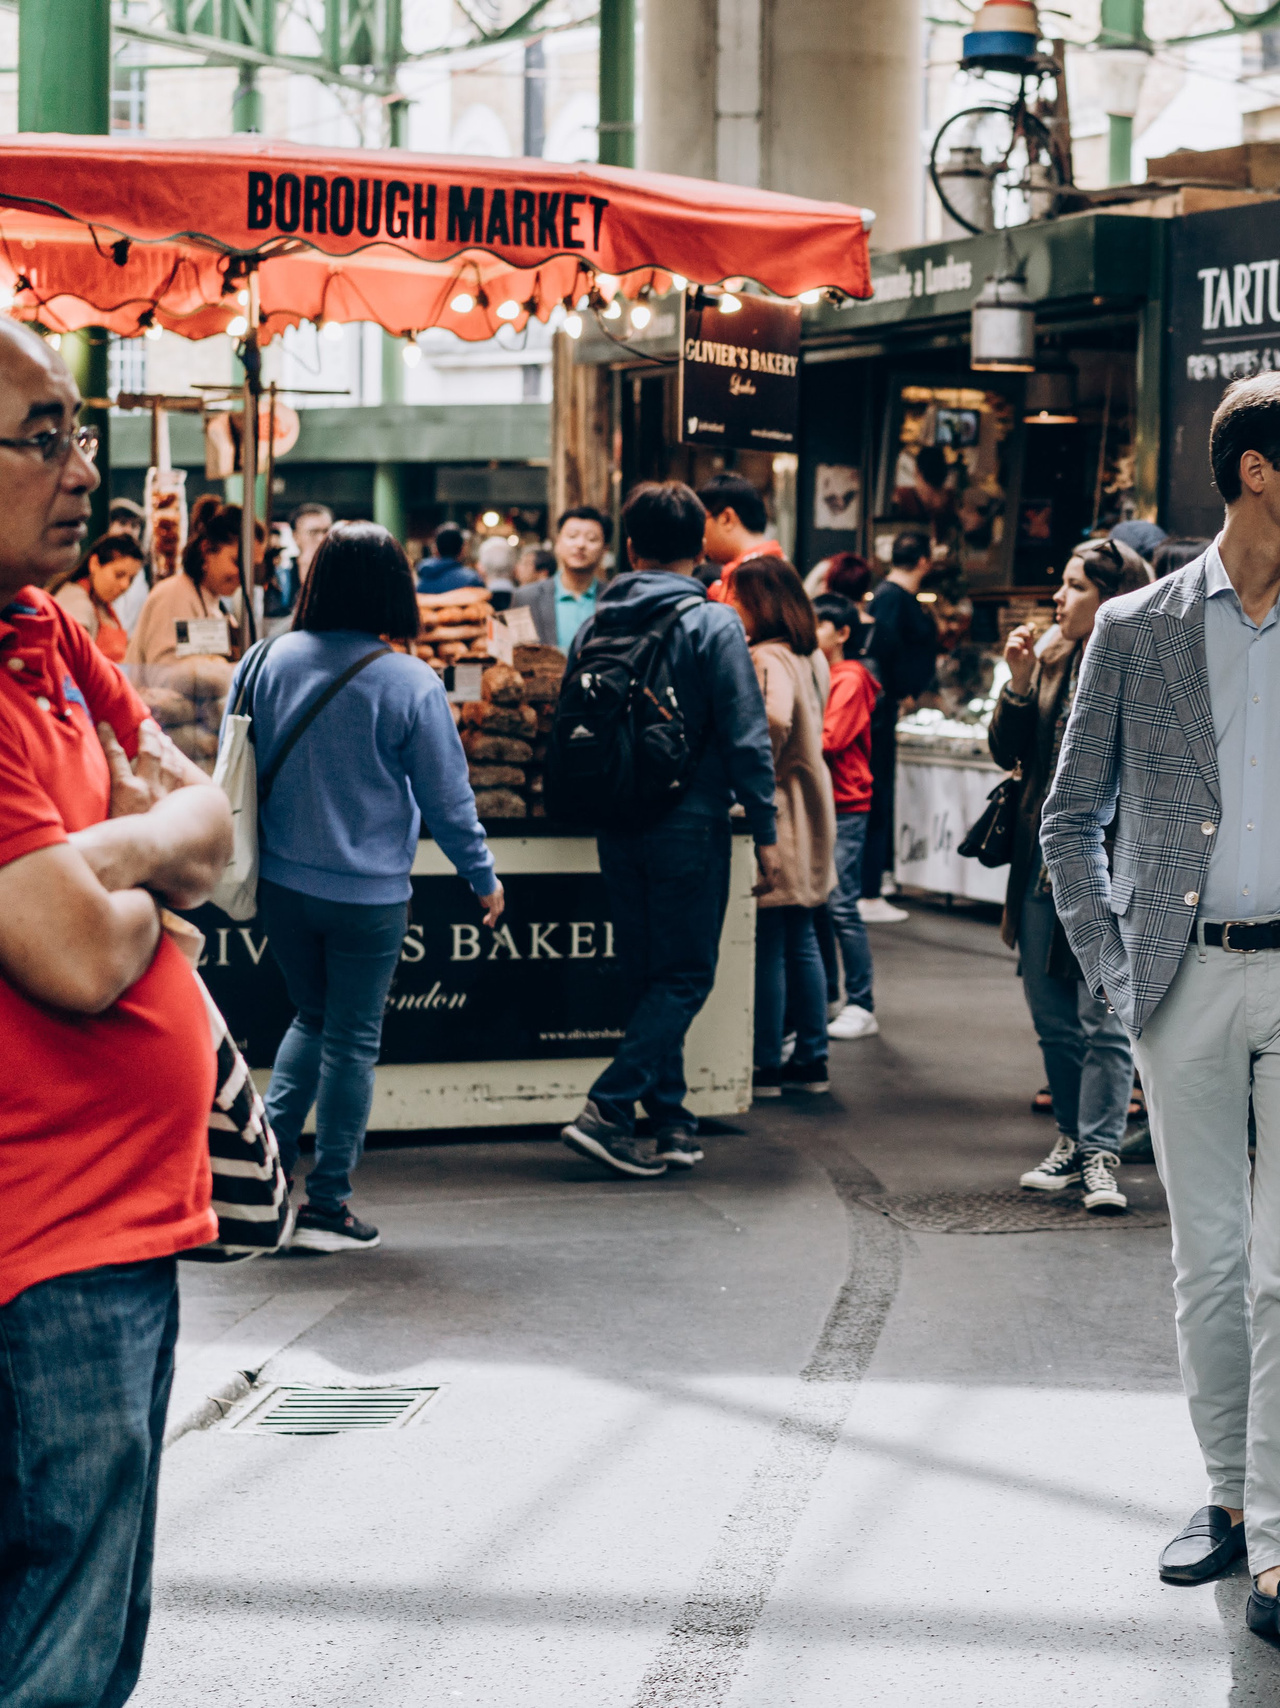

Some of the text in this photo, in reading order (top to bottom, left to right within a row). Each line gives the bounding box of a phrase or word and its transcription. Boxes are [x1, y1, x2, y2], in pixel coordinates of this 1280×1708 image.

[248, 171, 609, 251] BOROUGH MARKET
[749, 348, 798, 377] BAKERY
[384, 980, 467, 1011] ondon
